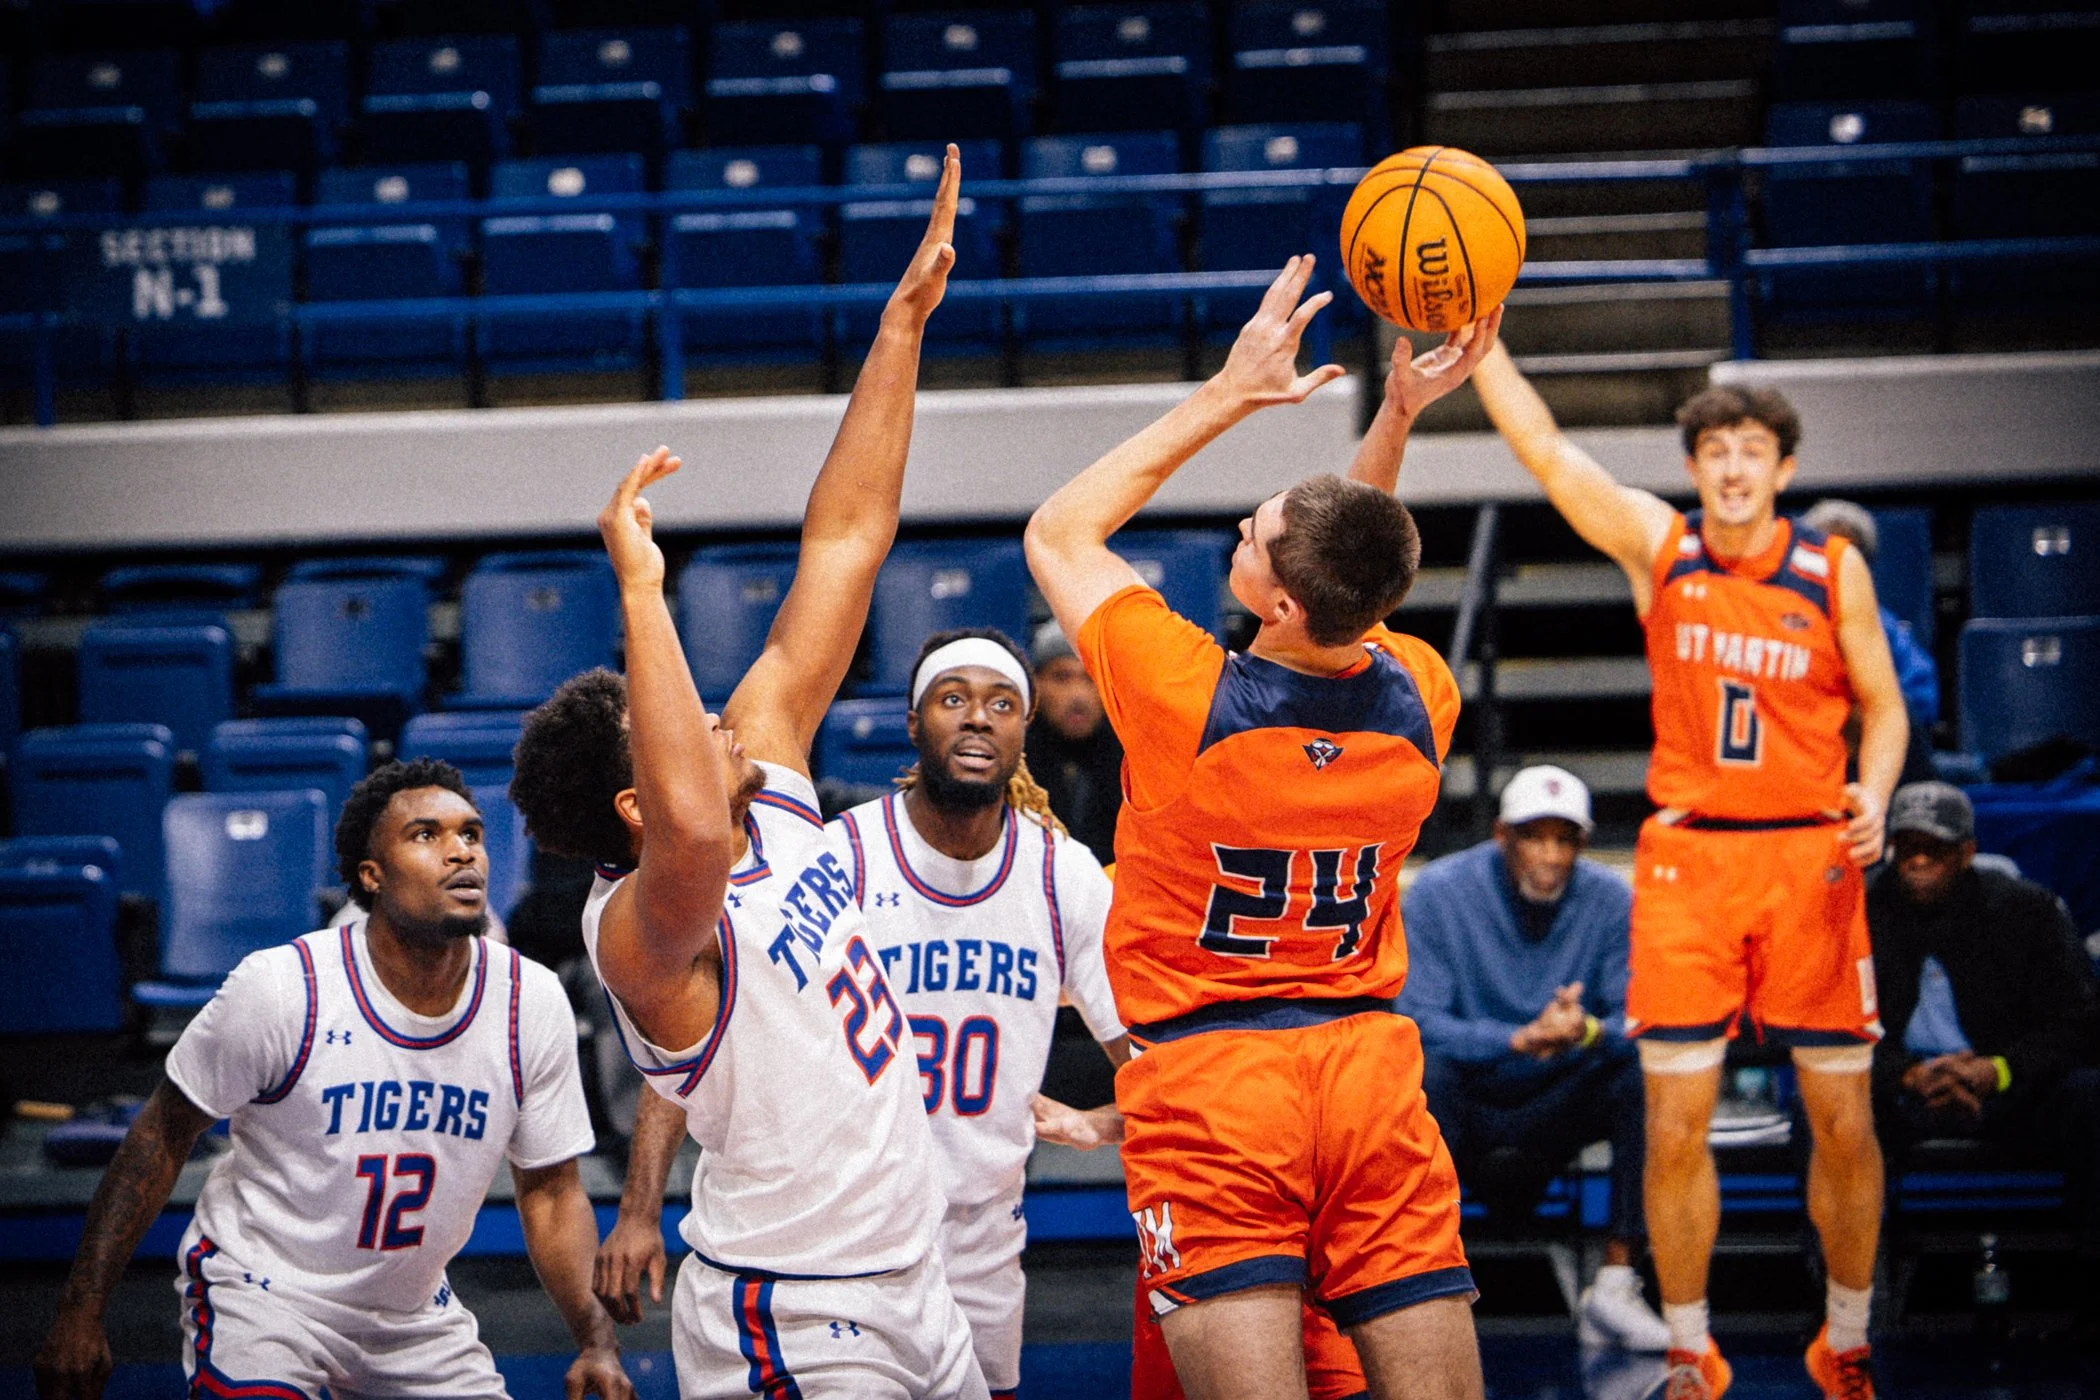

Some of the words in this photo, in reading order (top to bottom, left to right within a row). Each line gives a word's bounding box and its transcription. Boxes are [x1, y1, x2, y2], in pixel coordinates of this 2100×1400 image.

[103, 226, 255, 267] SECTION
[133, 264, 228, 320] N-1
[1675, 622, 1709, 664] UT
[1711, 630, 1812, 682] MARTIN
[1714, 675, 1765, 767] 0
[767, 850, 855, 994] TGERS
[1195, 841, 1387, 962] 24
[825, 934, 904, 1088] 23
[877, 938, 1038, 1002] TIGERS
[321, 1080, 490, 1140] TIGERS
[905, 1013, 1000, 1118] 30
[355, 1152, 436, 1252] 12
